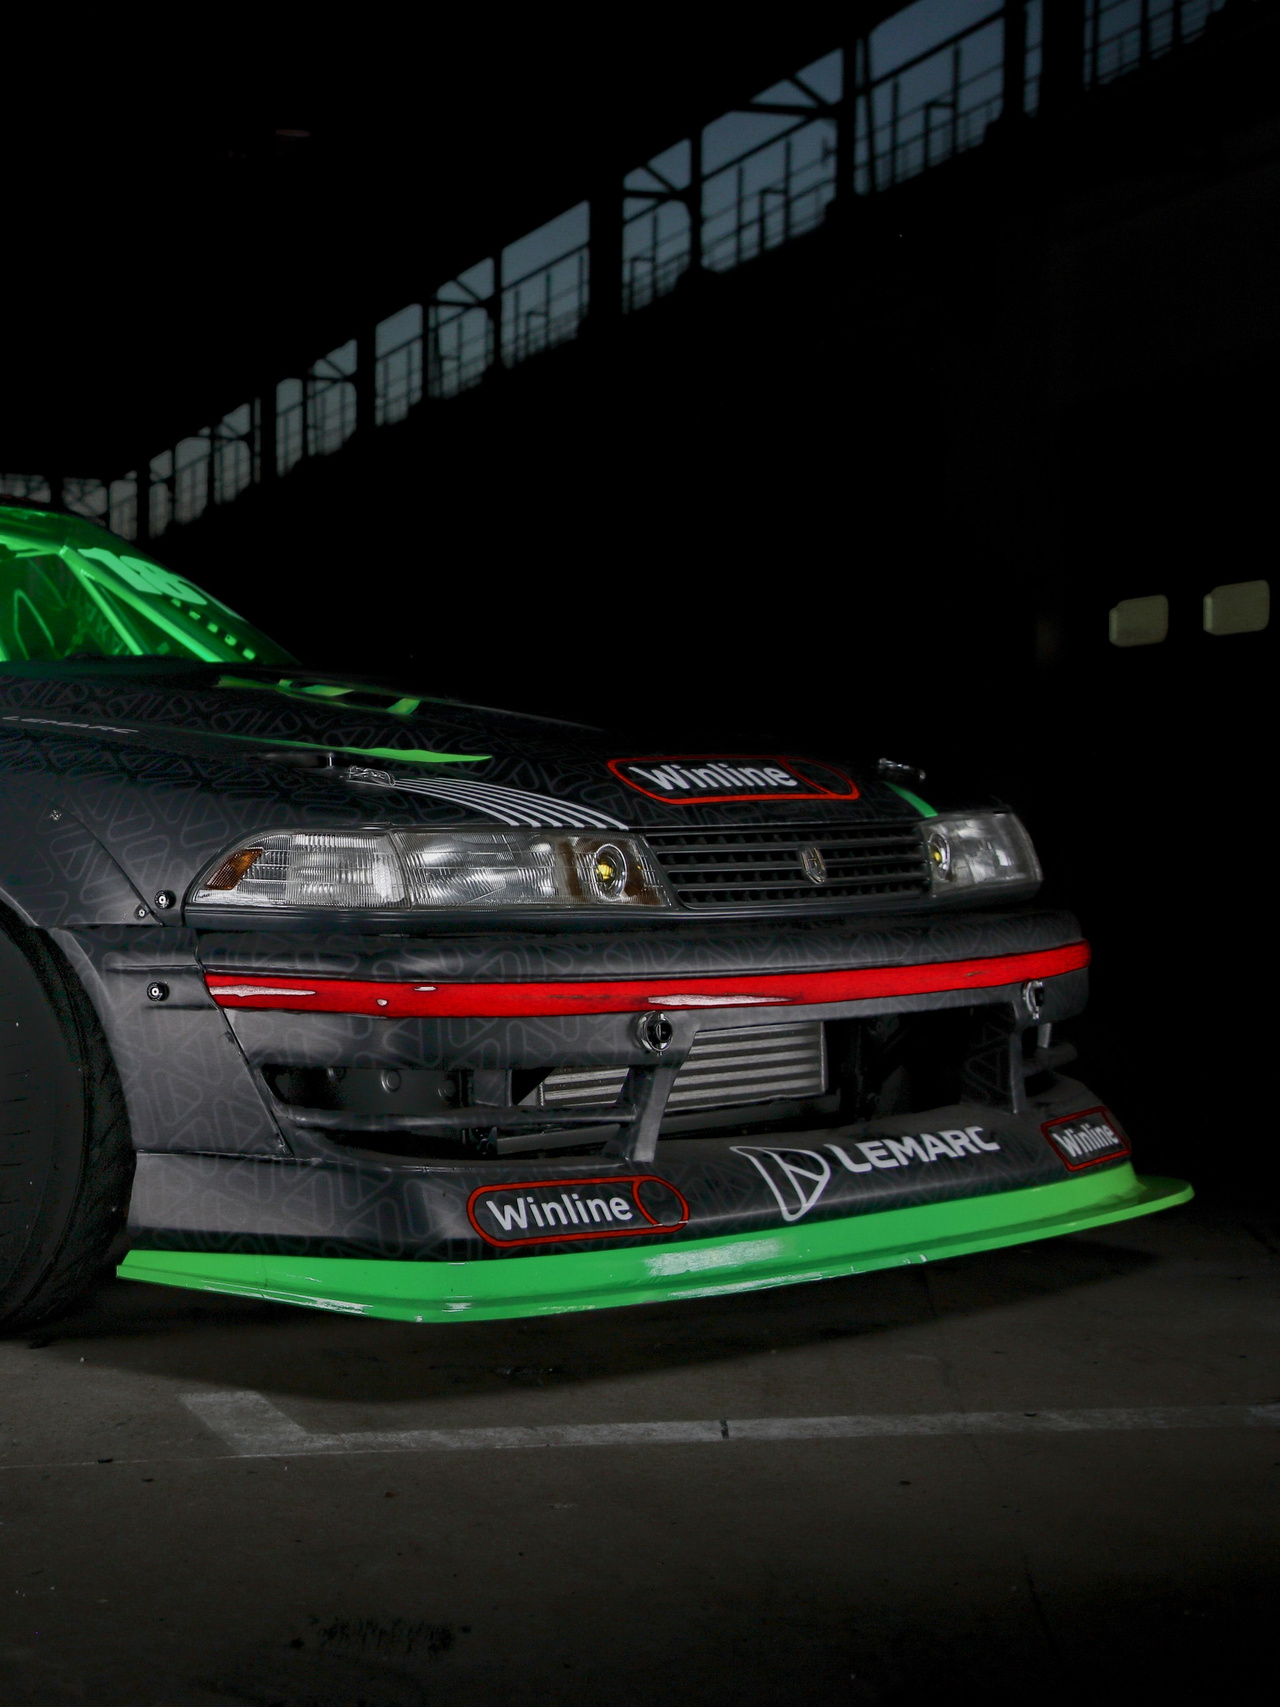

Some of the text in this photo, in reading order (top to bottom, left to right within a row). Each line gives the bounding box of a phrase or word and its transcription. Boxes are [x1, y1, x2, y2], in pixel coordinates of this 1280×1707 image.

[629, 763, 798, 790] Winline
[823, 1126, 1001, 1173] LEMARC
[1052, 1123, 1119, 1157] Winline
[486, 1193, 633, 1231] Winline
